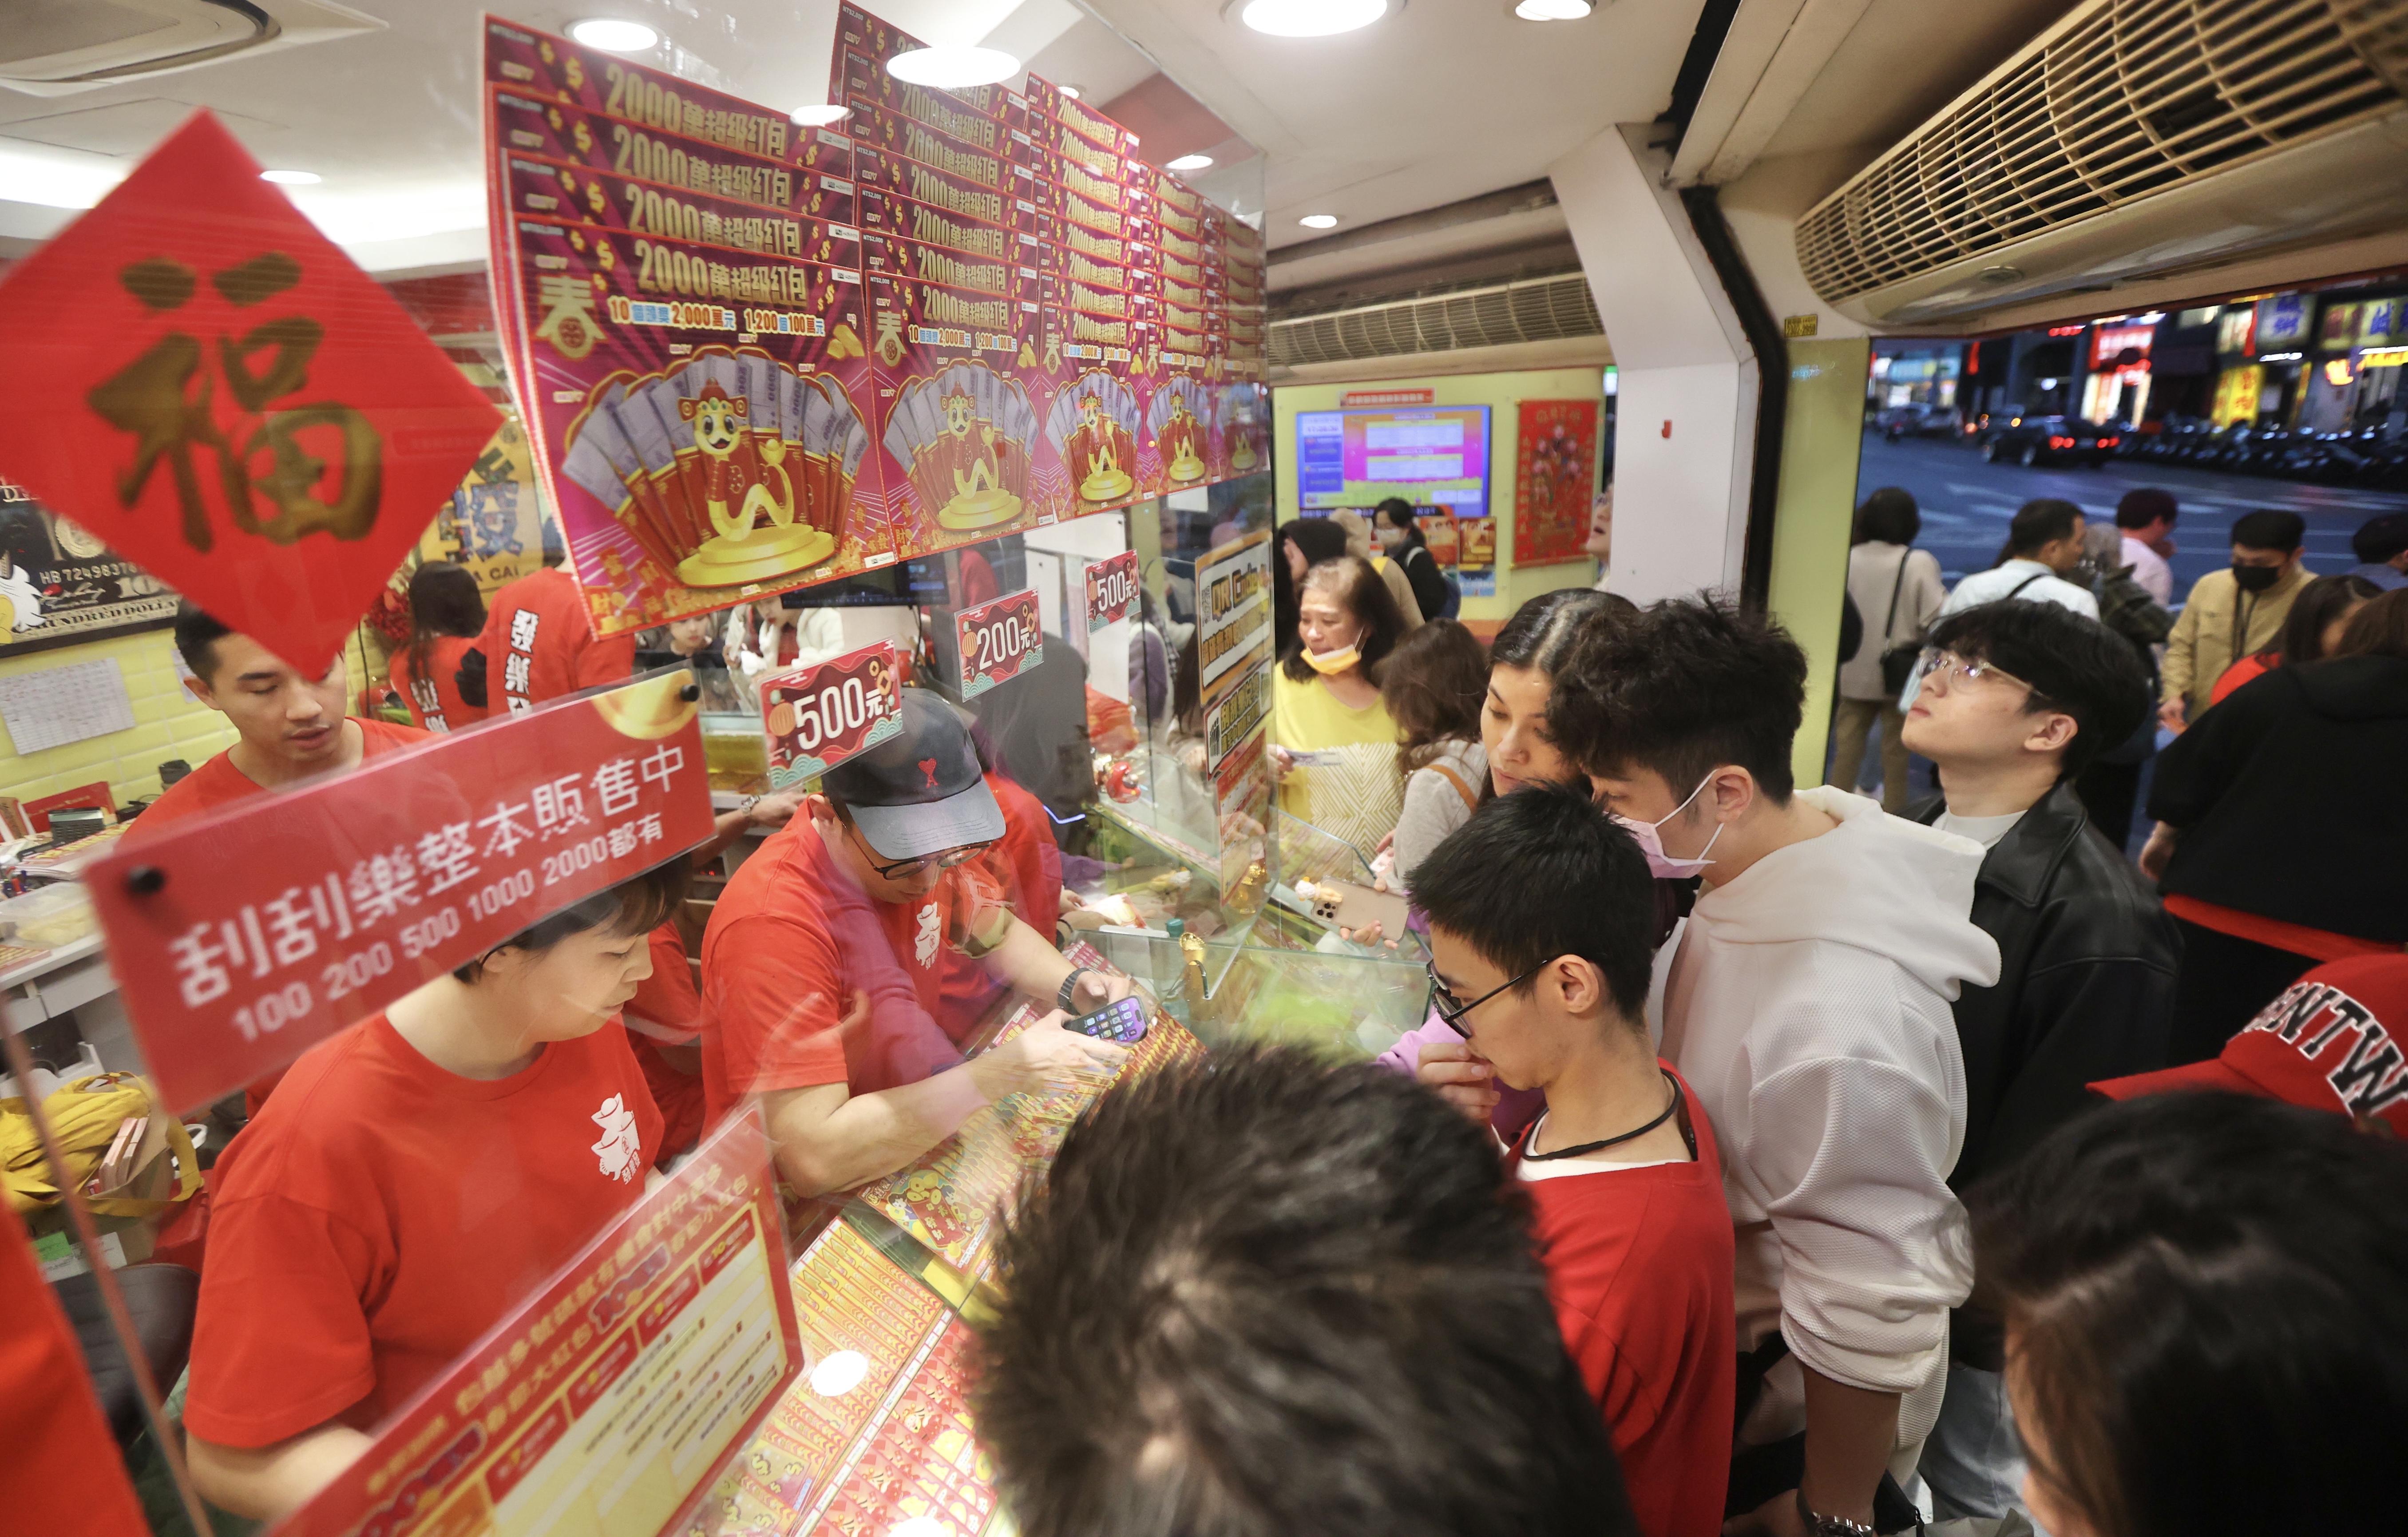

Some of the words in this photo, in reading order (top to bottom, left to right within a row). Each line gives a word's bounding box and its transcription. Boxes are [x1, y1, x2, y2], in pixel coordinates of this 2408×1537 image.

[87, 250, 384, 559] 福
[977, 616, 1031, 671] 200元
[1097, 574, 1133, 612] 500元
[793, 677, 882, 750] 500元
[170, 743, 685, 1009] 刮刮樂整本販售中
[233, 984, 311, 1042] 100
[324, 941, 393, 1002] 200
[402, 905, 461, 960] 500
[467, 867, 535, 923] 1000
[542, 812, 663, 887] 2000都有
